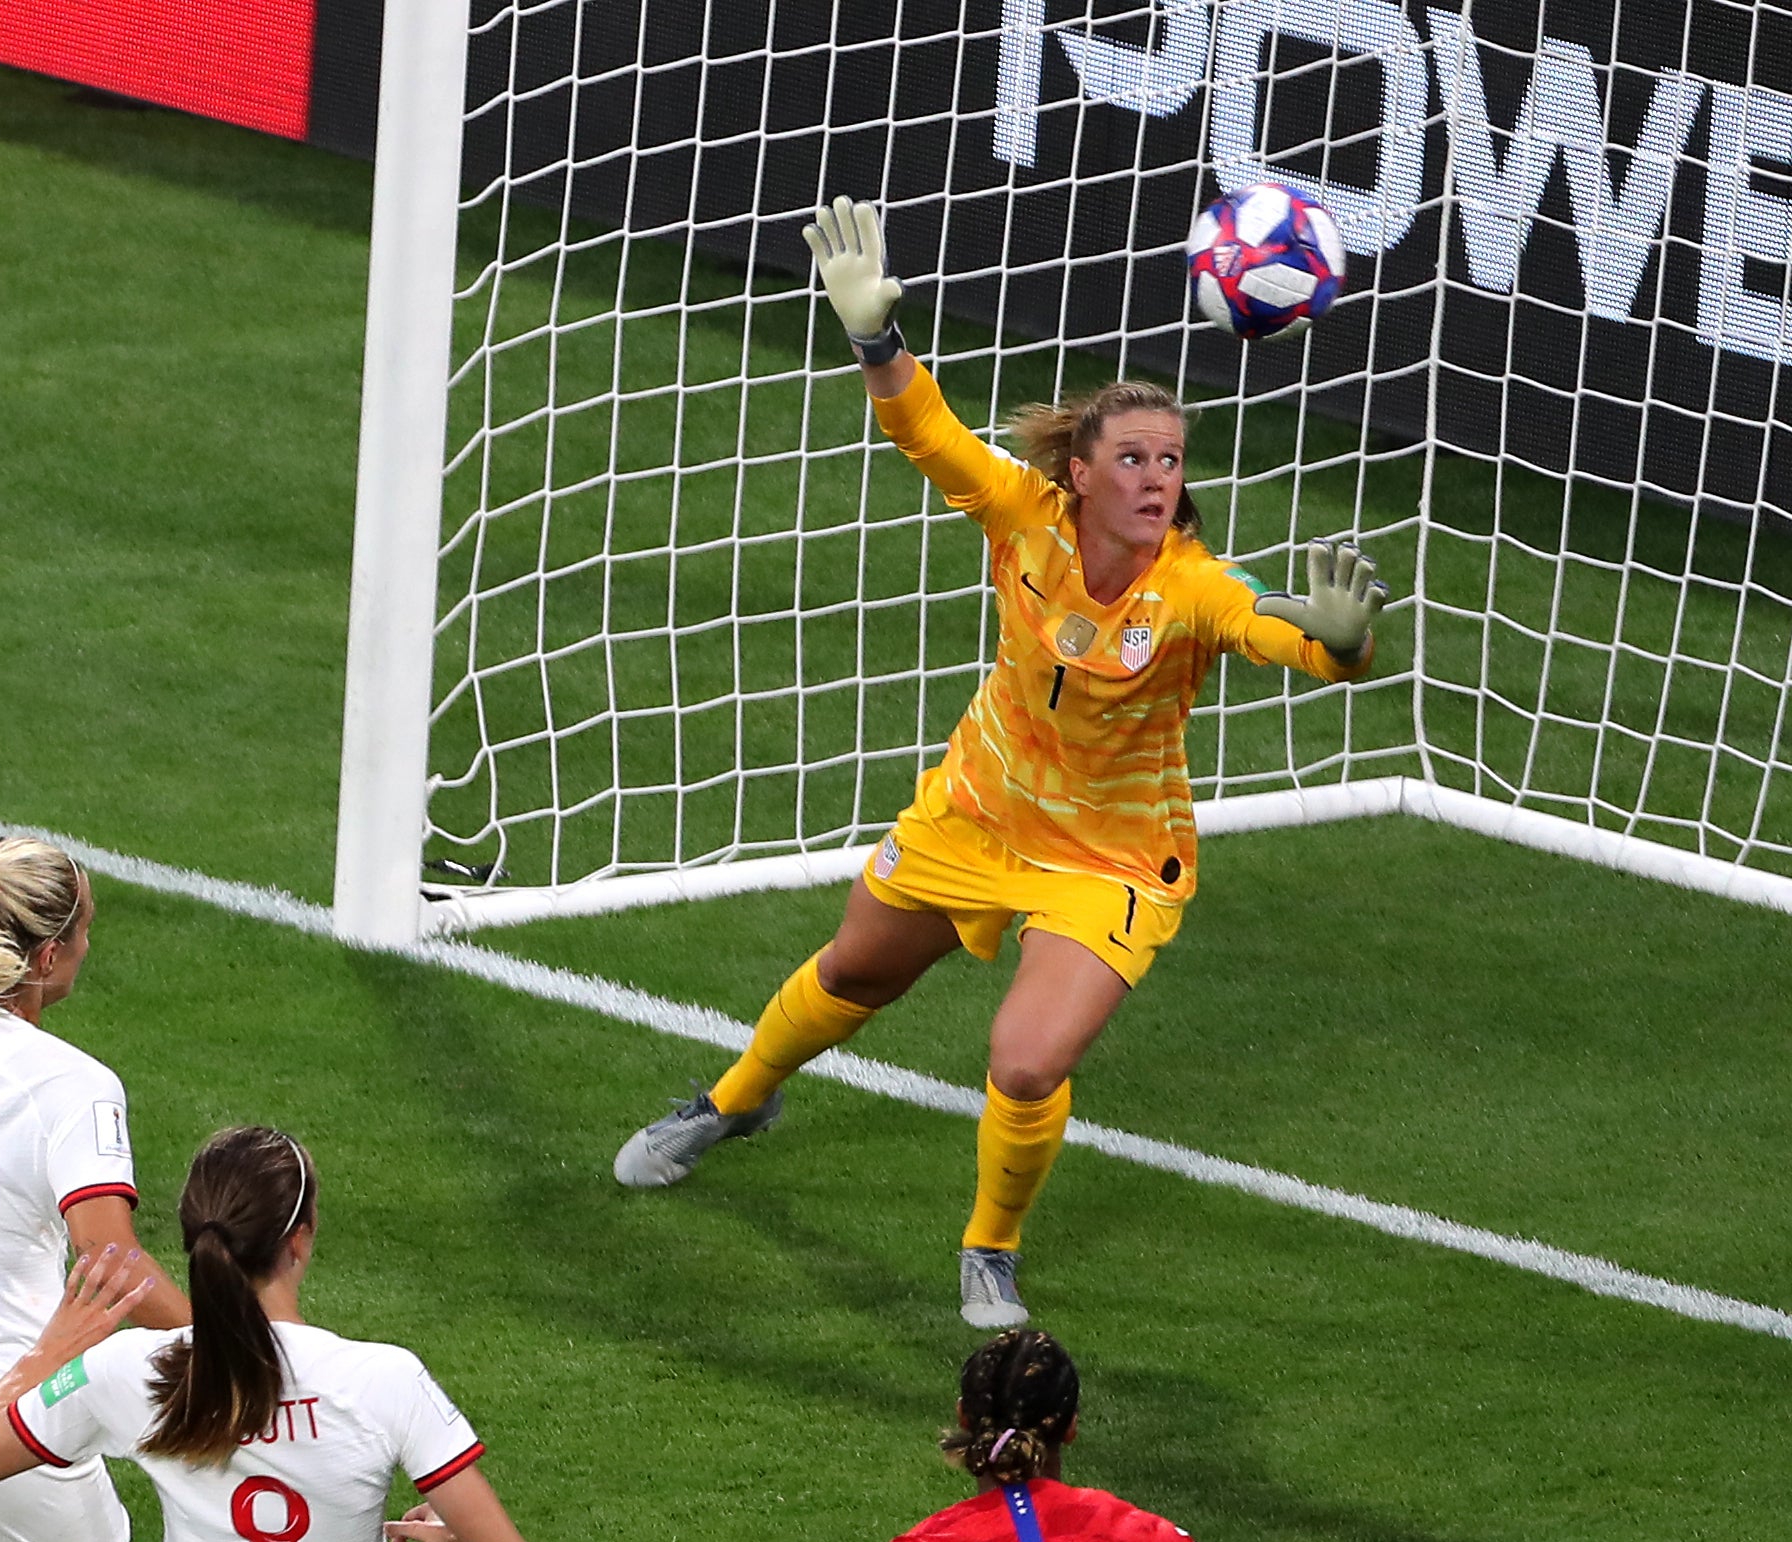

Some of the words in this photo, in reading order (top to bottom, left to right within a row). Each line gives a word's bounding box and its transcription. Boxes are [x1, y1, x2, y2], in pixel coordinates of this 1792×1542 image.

[1124, 629, 1148, 646] USA
[1048, 664, 1067, 711] 1
[1124, 884, 1137, 935] 1
